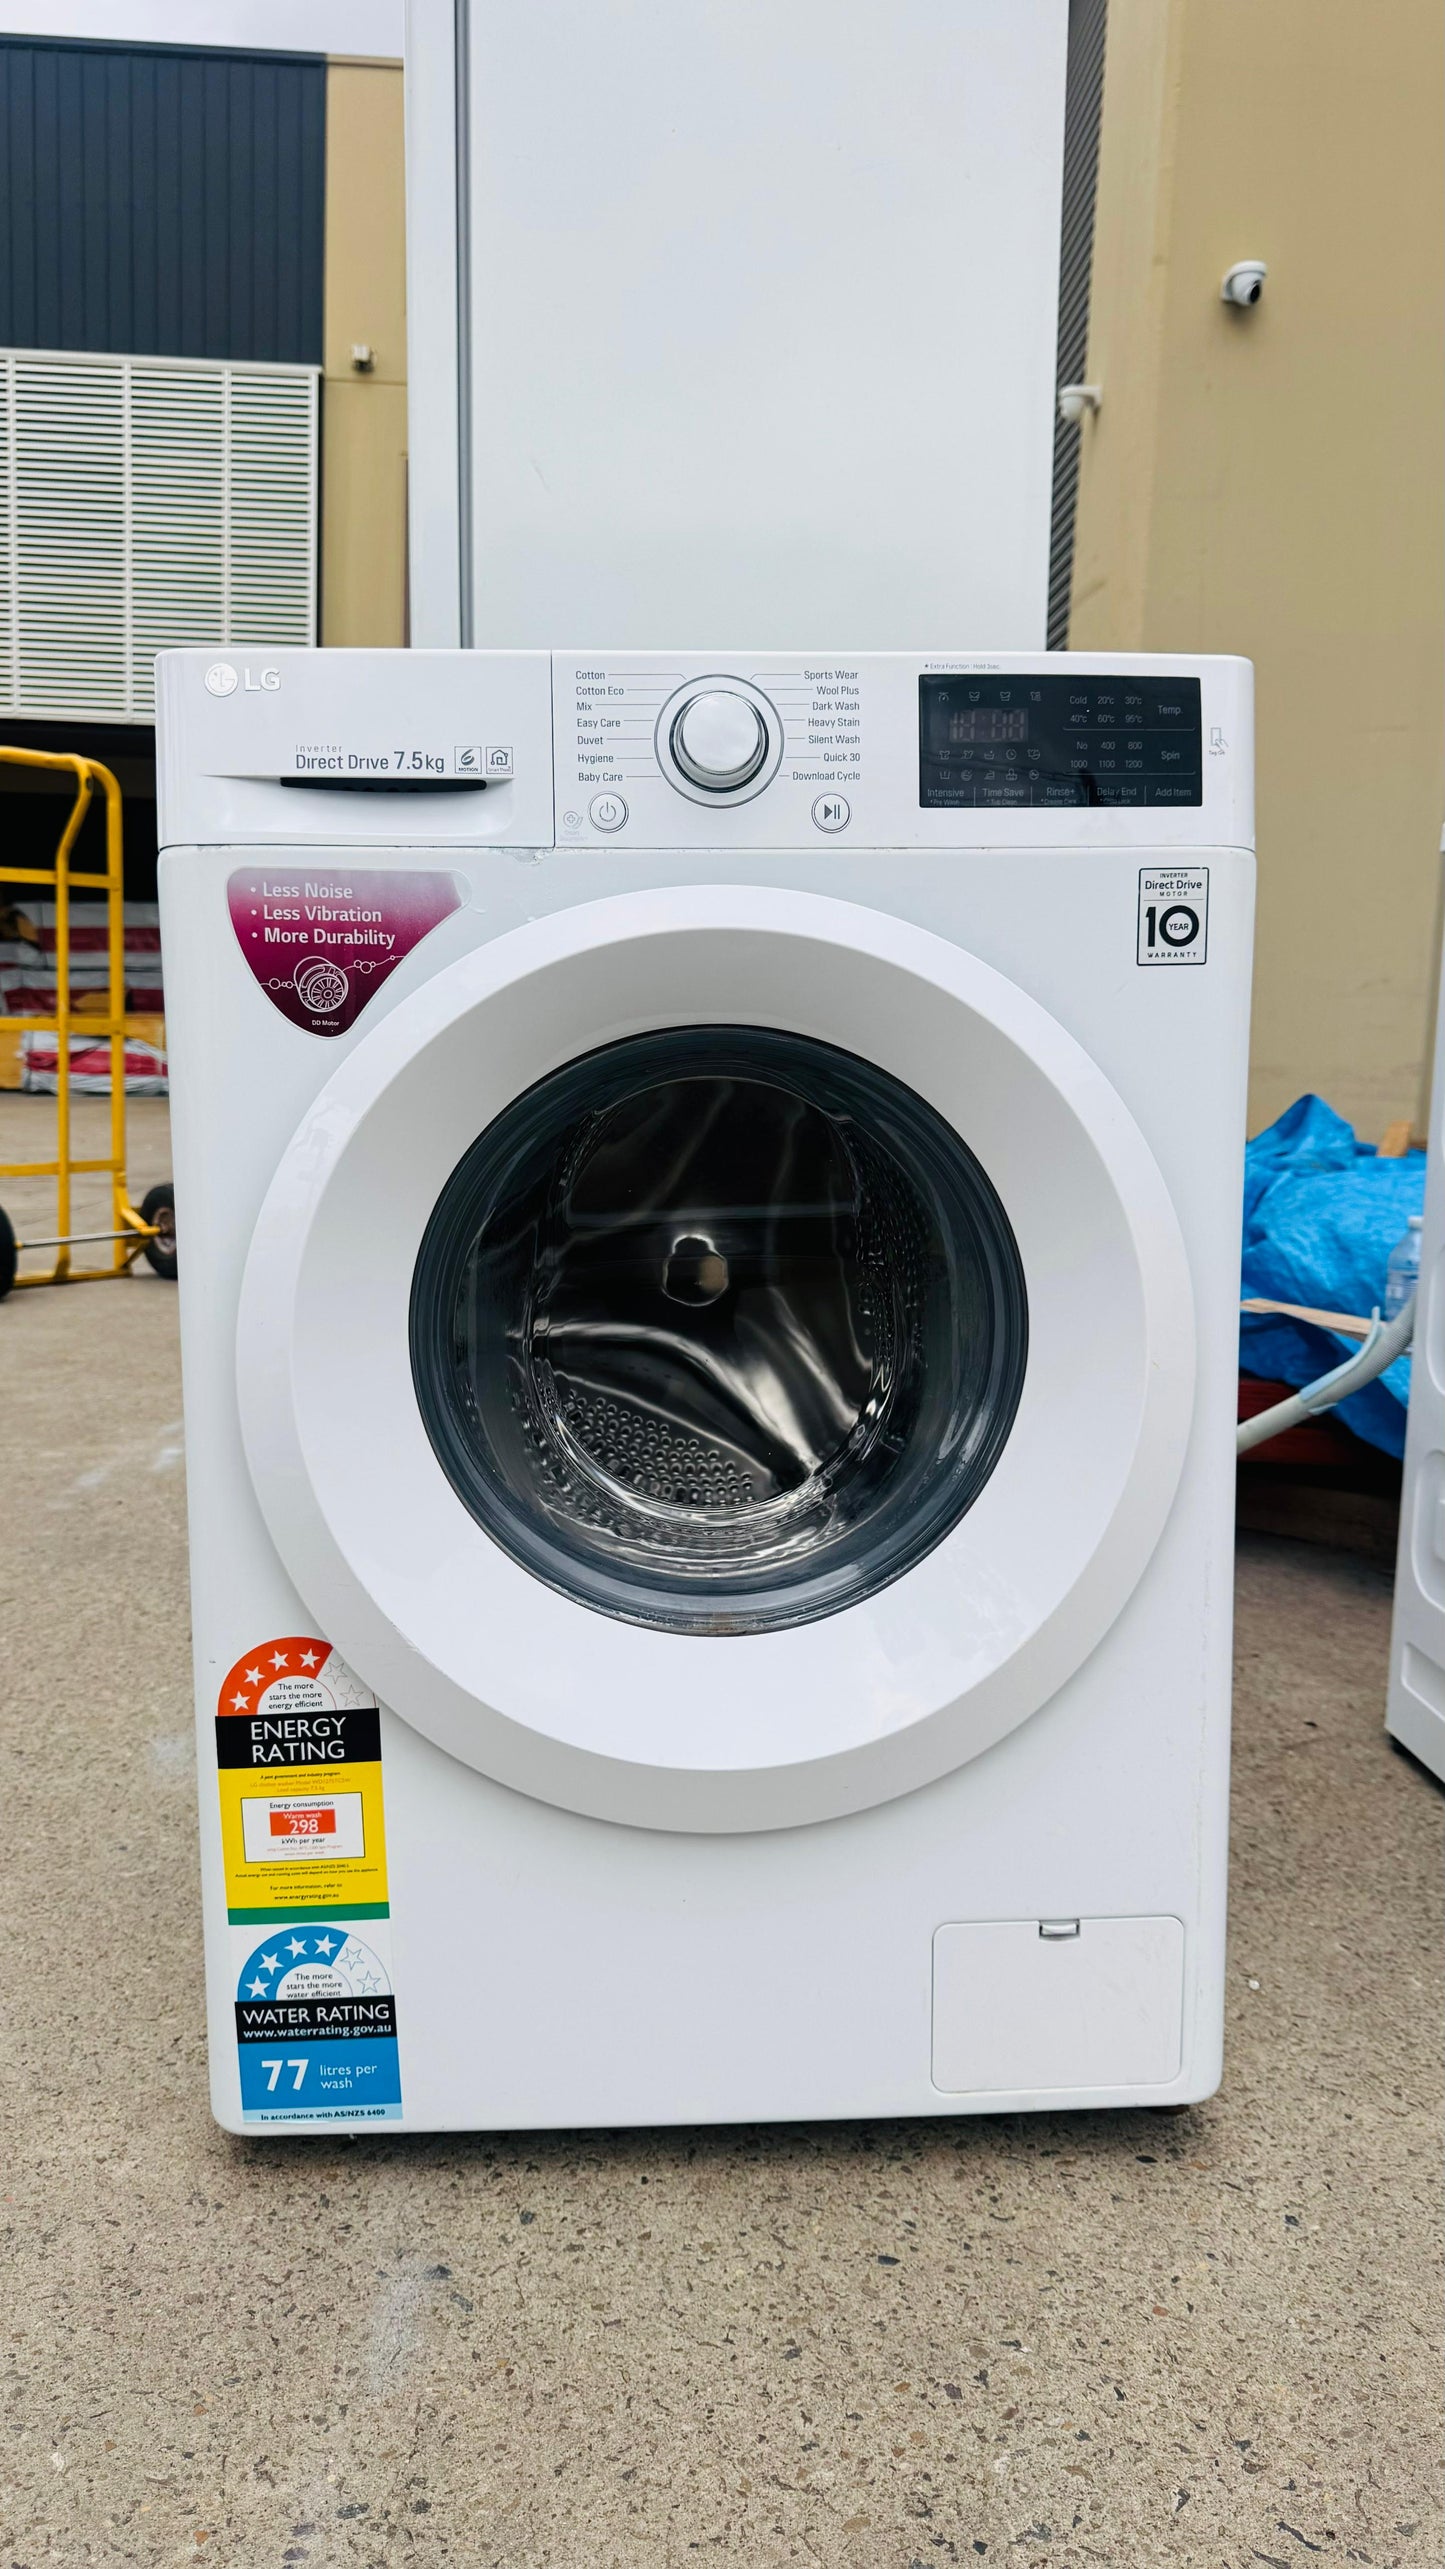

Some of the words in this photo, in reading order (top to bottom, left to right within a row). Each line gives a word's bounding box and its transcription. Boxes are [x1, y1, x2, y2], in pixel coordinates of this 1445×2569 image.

[244, 668, 281, 691] LG
[576, 671, 605, 680] Cotton
[804, 671, 833, 681] Sports
[835, 671, 858, 680] Wear
[576, 686, 606, 695] Cotton
[607, 687, 624, 695] Eco
[816, 686, 839, 695] Wool
[841, 686, 860, 695] Plus
[1069, 696, 1087, 705] Cold
[577, 702, 592, 711] Mix
[813, 702, 833, 711] Dark
[835, 702, 860, 711] Wash
[577, 718, 598, 729] Easy
[600, 718, 621, 728] Care
[808, 718, 835, 729] Heavy
[838, 718, 860, 727] Stain
[577, 735, 604, 745] Duvet
[808, 735, 833, 744] Silent
[836, 735, 860, 744] Wash
[295, 744, 343, 752] Inverter
[1077, 741, 1088, 750] No
[1101, 741, 1116, 750] 400
[1128, 741, 1143, 750] 800
[577, 753, 614, 764] Hygiene
[823, 753, 848, 762] Quick
[850, 753, 861, 762] 30
[1161, 751, 1180, 761] Spin
[296, 754, 344, 770] Direct
[348, 754, 389, 770] Drive
[1070, 759, 1088, 768] 1000
[1099, 759, 1116, 768] 1100
[1126, 759, 1143, 768] 1200
[578, 772, 601, 783] Baby
[602, 772, 624, 781] Care
[792, 771, 835, 780] Download
[837, 771, 861, 781] Cycle
[927, 788, 965, 798] Intensive
[982, 787, 1002, 798] Time
[1003, 787, 1025, 798] Save
[1046, 786, 1075, 797] Rinse+
[1155, 787, 1173, 797] Add
[1145, 880, 1175, 890] Direct
[1176, 880, 1203, 889] Drive
[263, 882, 300, 898] Less
[304, 883, 353, 899] Noise
[263, 904, 301, 921] Less
[304, 905, 382, 923] Vibration
[1145, 905, 1200, 948] 10
[1168, 923, 1190, 931] YEAR
[264, 927, 309, 944] More
[313, 928, 396, 950] Durability
[322, 1019, 340, 1027] Motor
[268, 1702, 293, 1710] energy
[294, 1700, 323, 1709] efficient
[250, 1717, 347, 1740] ENERGY
[252, 1740, 345, 1763] RATING
[269, 1802, 291, 1810] Energy
[293, 1800, 334, 1808] consumption
[289, 1819, 319, 1834] 298
[295, 1972, 310, 1980] The
[311, 1990, 341, 1998] efficient
[243, 2008, 310, 2025] WATER
[316, 2004, 390, 2022] RATING
[243, 2025, 392, 2038] www.waterrating.gov.au
[261, 2058, 309, 2092] 77
[320, 2065, 351, 2076] litres
[356, 2064, 377, 2076] per
[320, 2077, 353, 2089] wash
[271, 2112, 314, 2120] accordance
[367, 2108, 386, 2116] 6400
